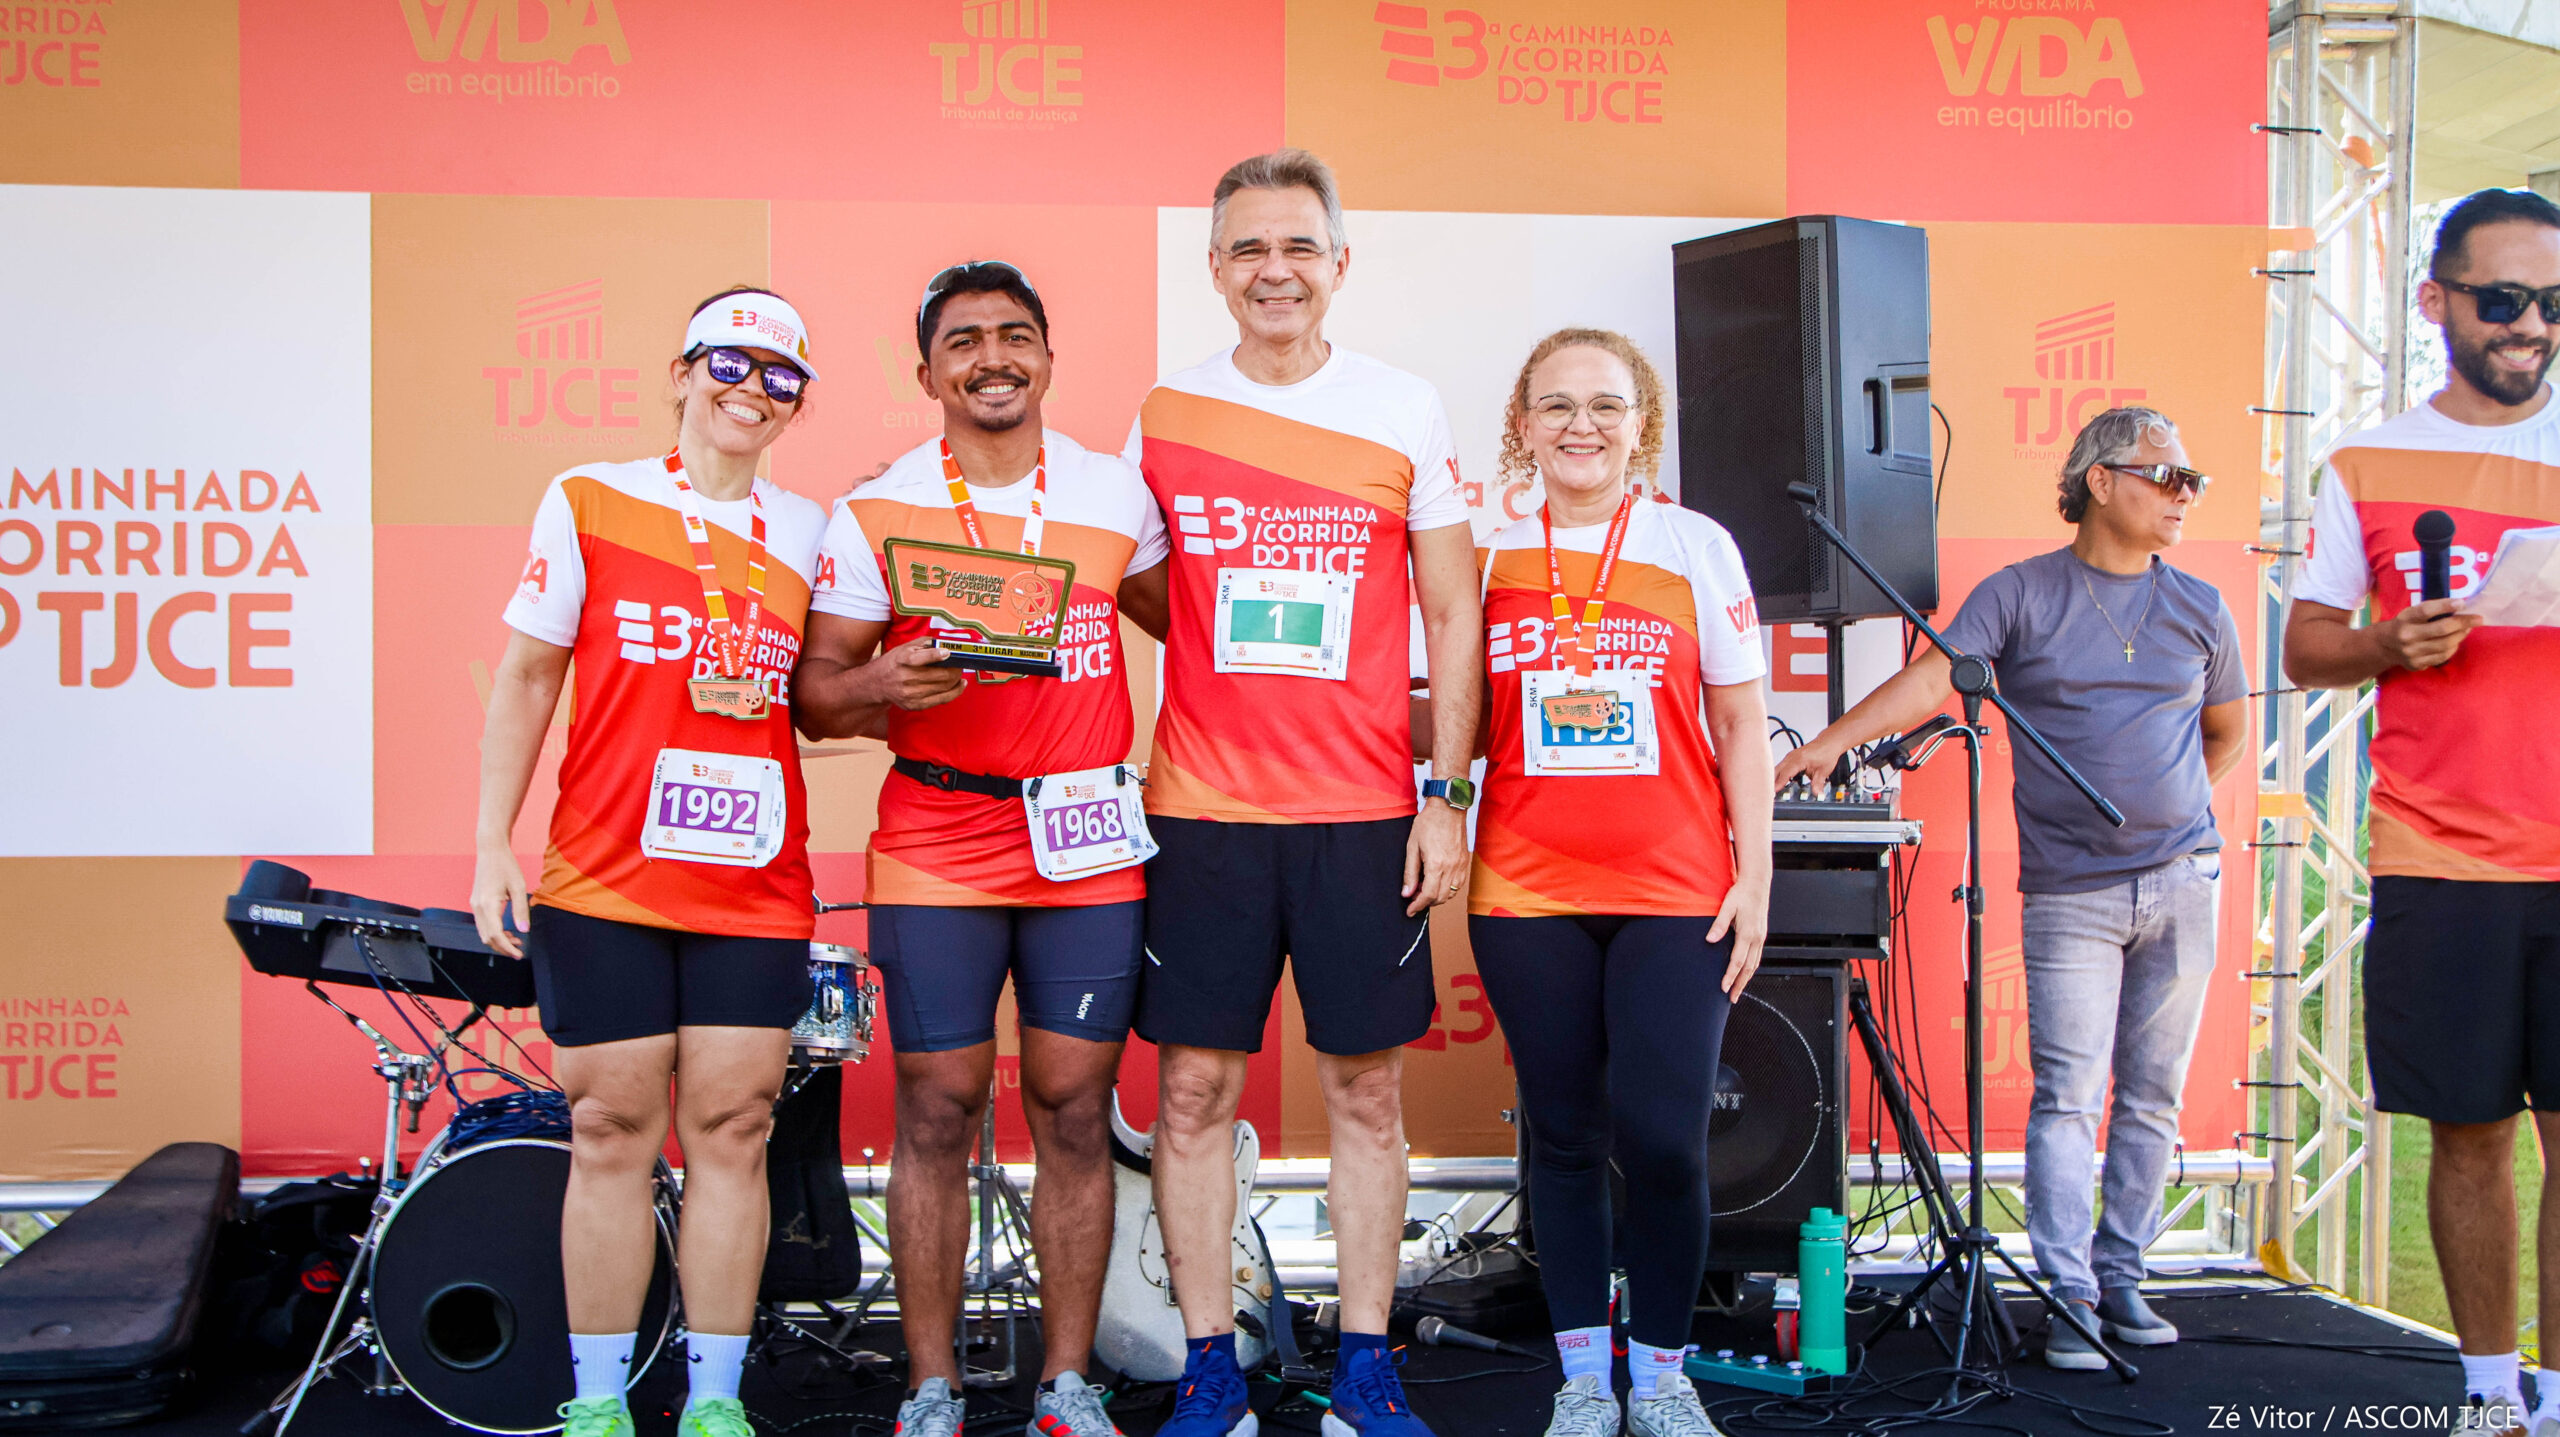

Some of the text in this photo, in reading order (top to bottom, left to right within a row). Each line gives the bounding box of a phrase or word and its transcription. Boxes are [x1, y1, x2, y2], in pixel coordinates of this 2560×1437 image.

[1509, 23, 1675, 47] CAMINHADA
[929, 42, 1083, 106] TJCE
[1926, 15, 2144, 99] VIDA
[405, 66, 621, 104] em equilíbrio
[1498, 75, 1663, 124] DO TJCE
[940, 106, 1078, 124] Tribunal de Justiça
[1937, 99, 2133, 136] em equilíbrio
[481, 366, 640, 429] TJCE
[0, 467, 322, 513] MINHADA
[1261, 507, 1378, 523] CAMINHADA
[1253, 545, 1289, 566] DO
[965, 590, 1001, 608] TJCE
[1222, 585, 1230, 605] 3KM
[37, 591, 294, 689] TJCE
[1268, 604, 1284, 640] 1
[984, 646, 1014, 656] LUGAR
[1529, 687, 1537, 708] 5KM
[664, 785, 757, 832] 1992
[1033, 801, 1041, 819] 10K
[1048, 801, 1123, 848] 1968
